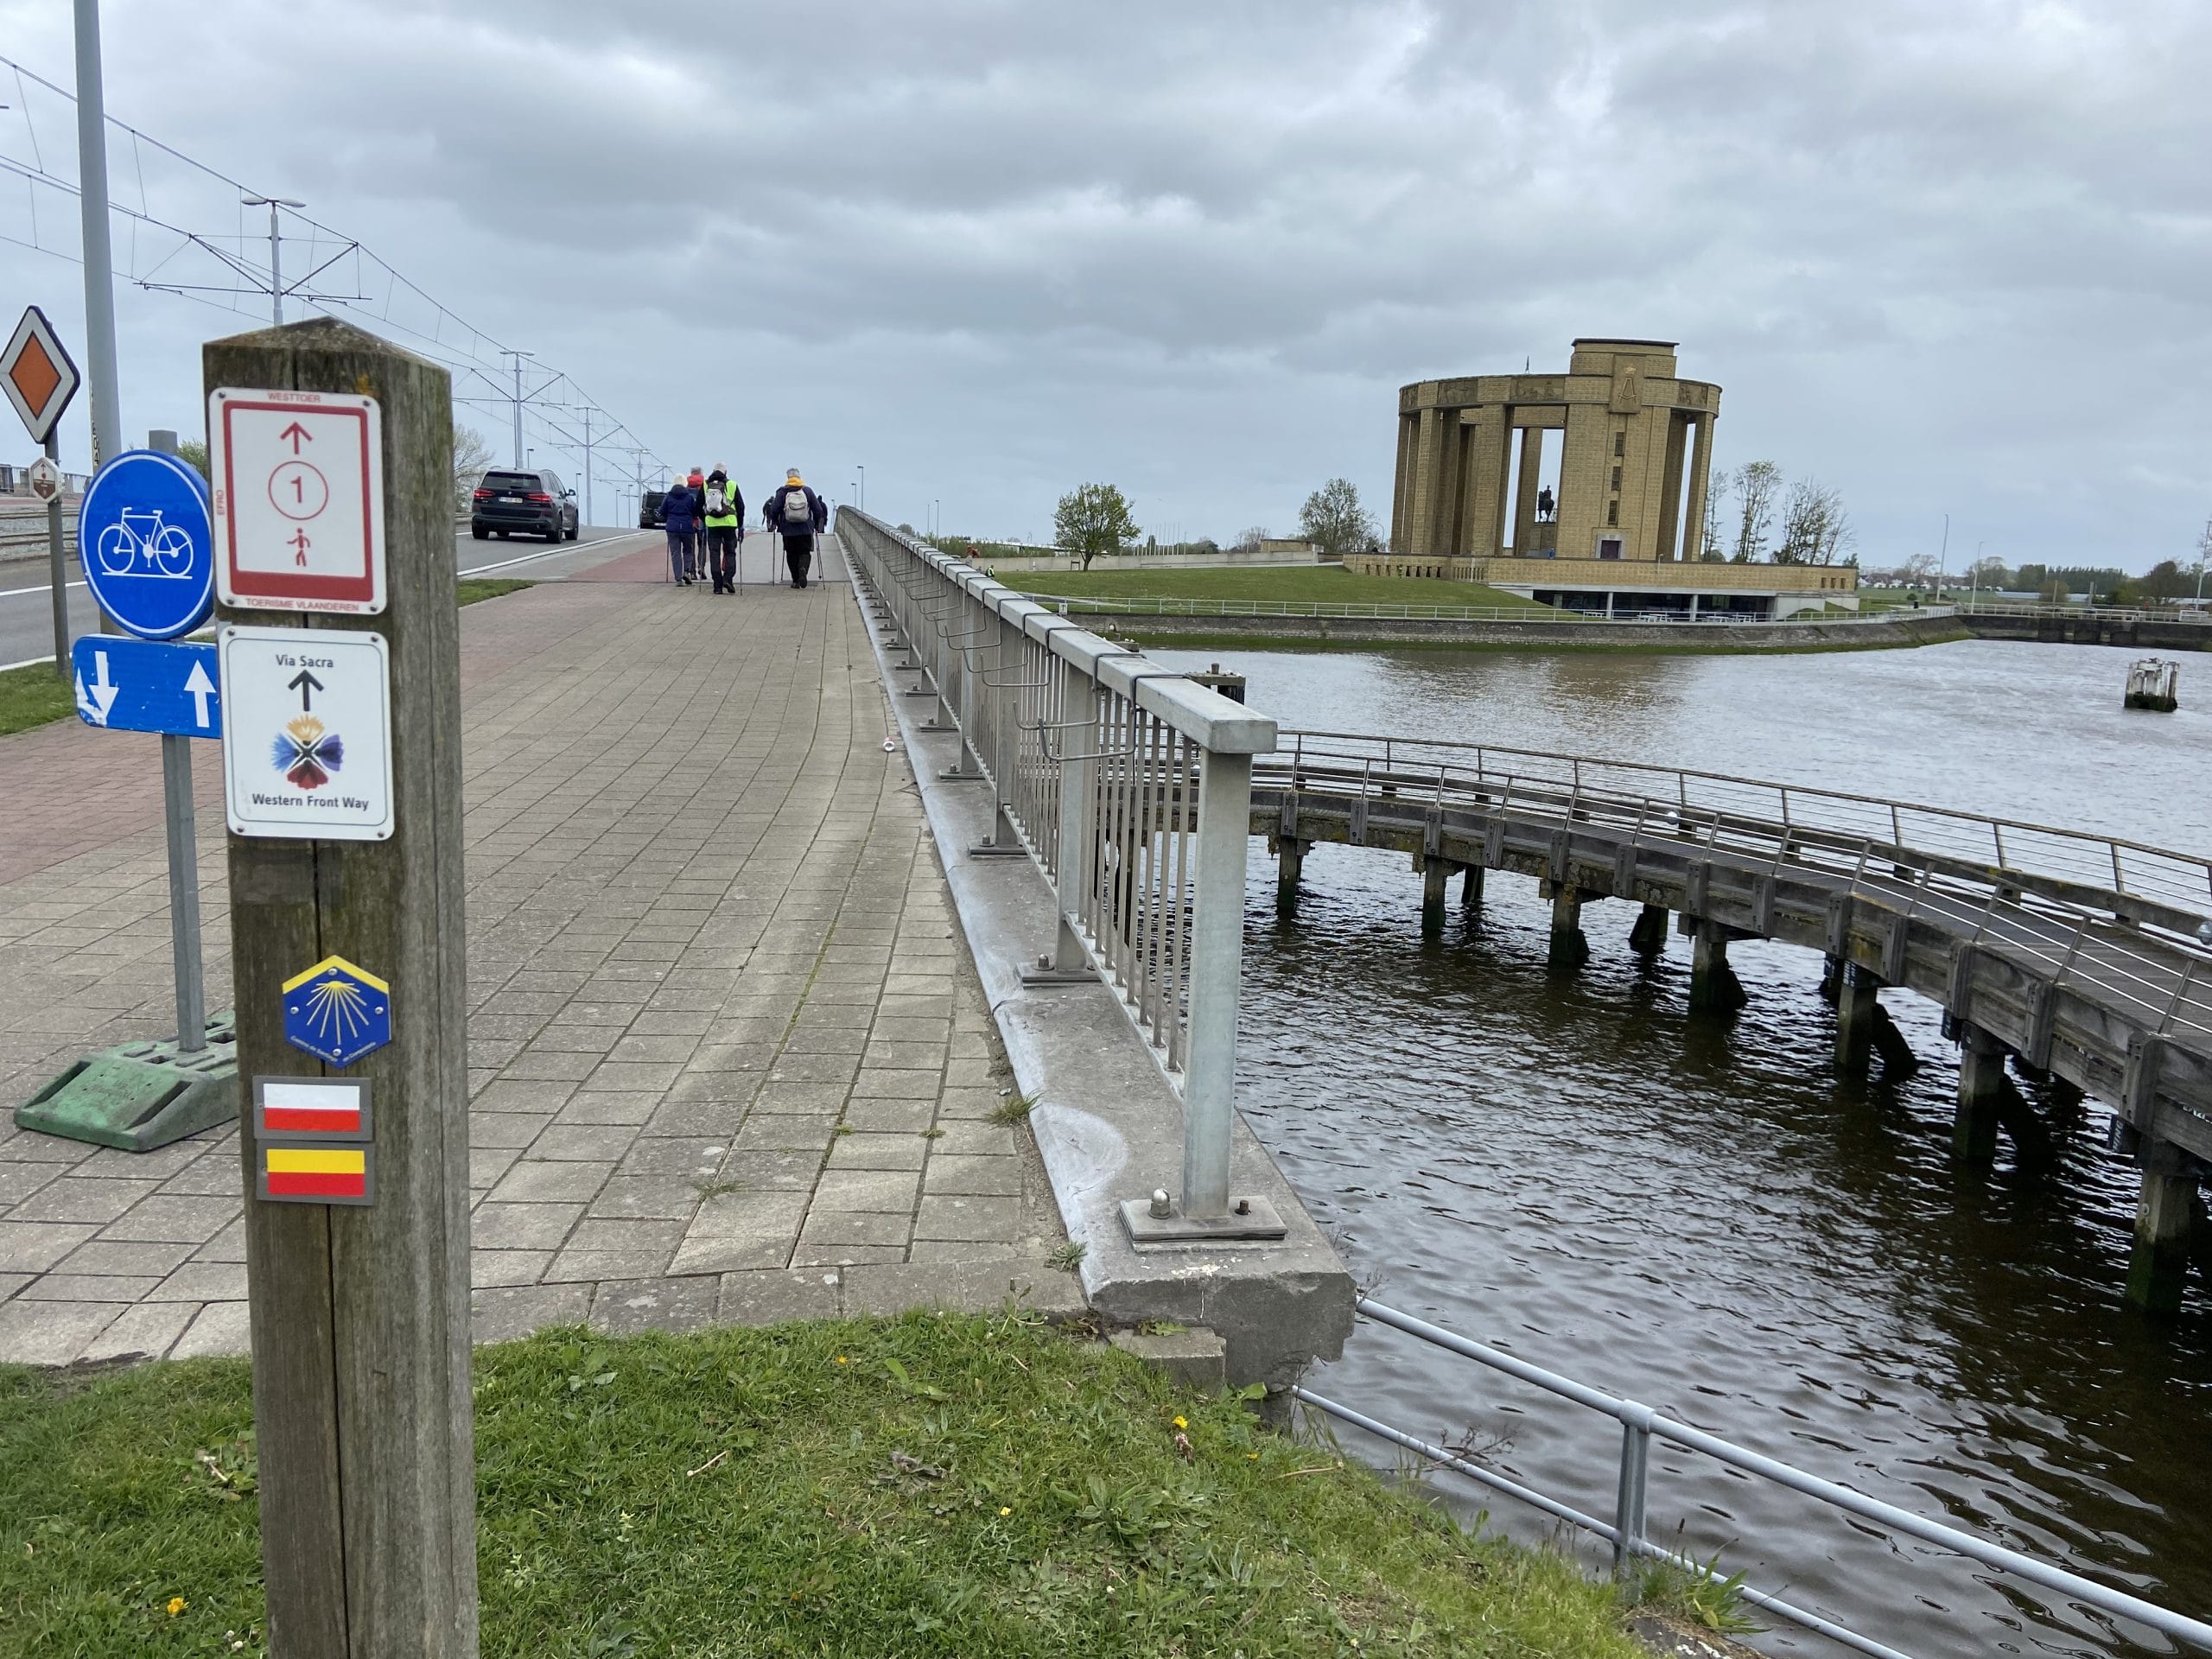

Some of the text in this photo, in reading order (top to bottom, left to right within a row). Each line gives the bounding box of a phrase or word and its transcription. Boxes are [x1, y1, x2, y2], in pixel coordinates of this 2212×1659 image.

[268, 392, 321, 403] WESTTOER
[290, 475, 302, 504] 1
[215, 489, 226, 516] EFRO
[246, 598, 359, 612] TOERISME VLAANDEREN
[276, 654, 334, 669] Via Sacra
[251, 793, 370, 812] Western Front Way
